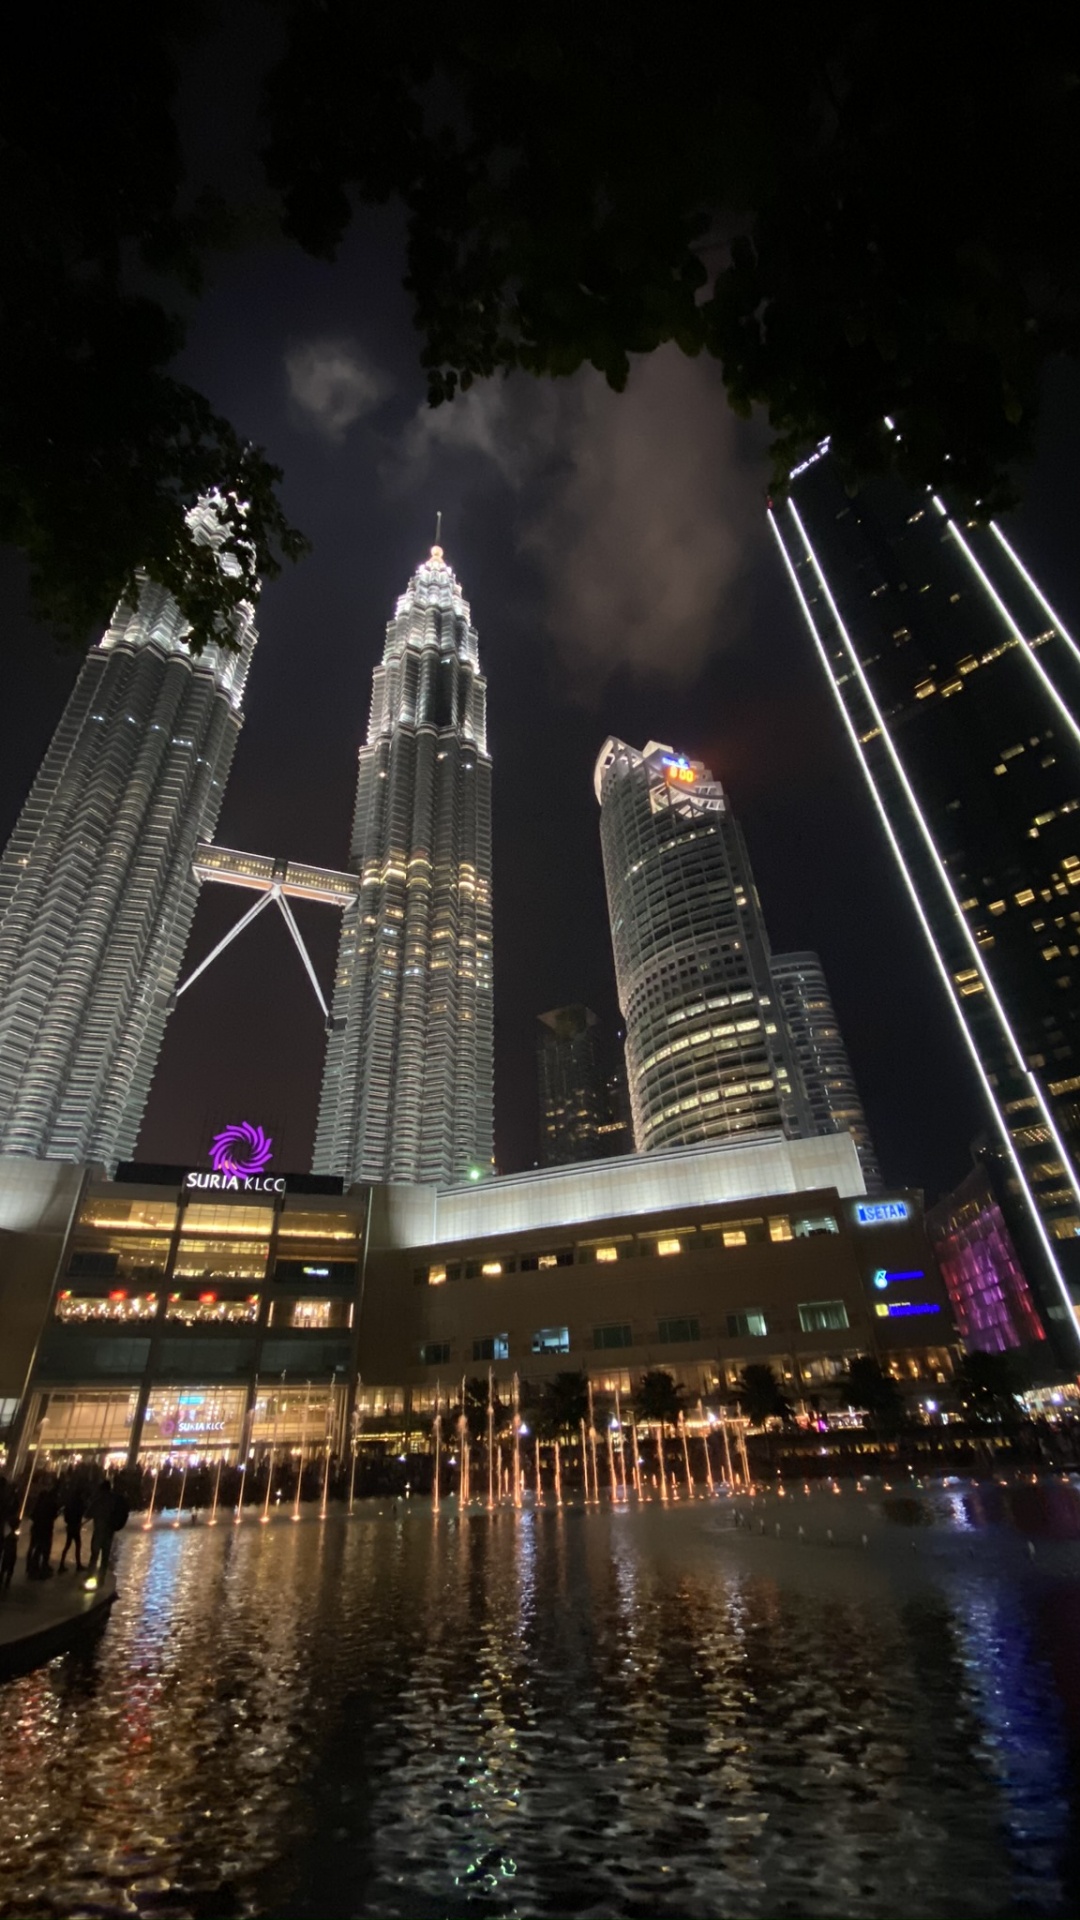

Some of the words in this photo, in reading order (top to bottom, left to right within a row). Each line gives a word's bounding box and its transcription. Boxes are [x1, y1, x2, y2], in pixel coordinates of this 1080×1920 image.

[186, 1172, 239, 1191] SURIA
[244, 1176, 286, 1193] KLCC
[205, 1421, 225, 1431] KLCC
